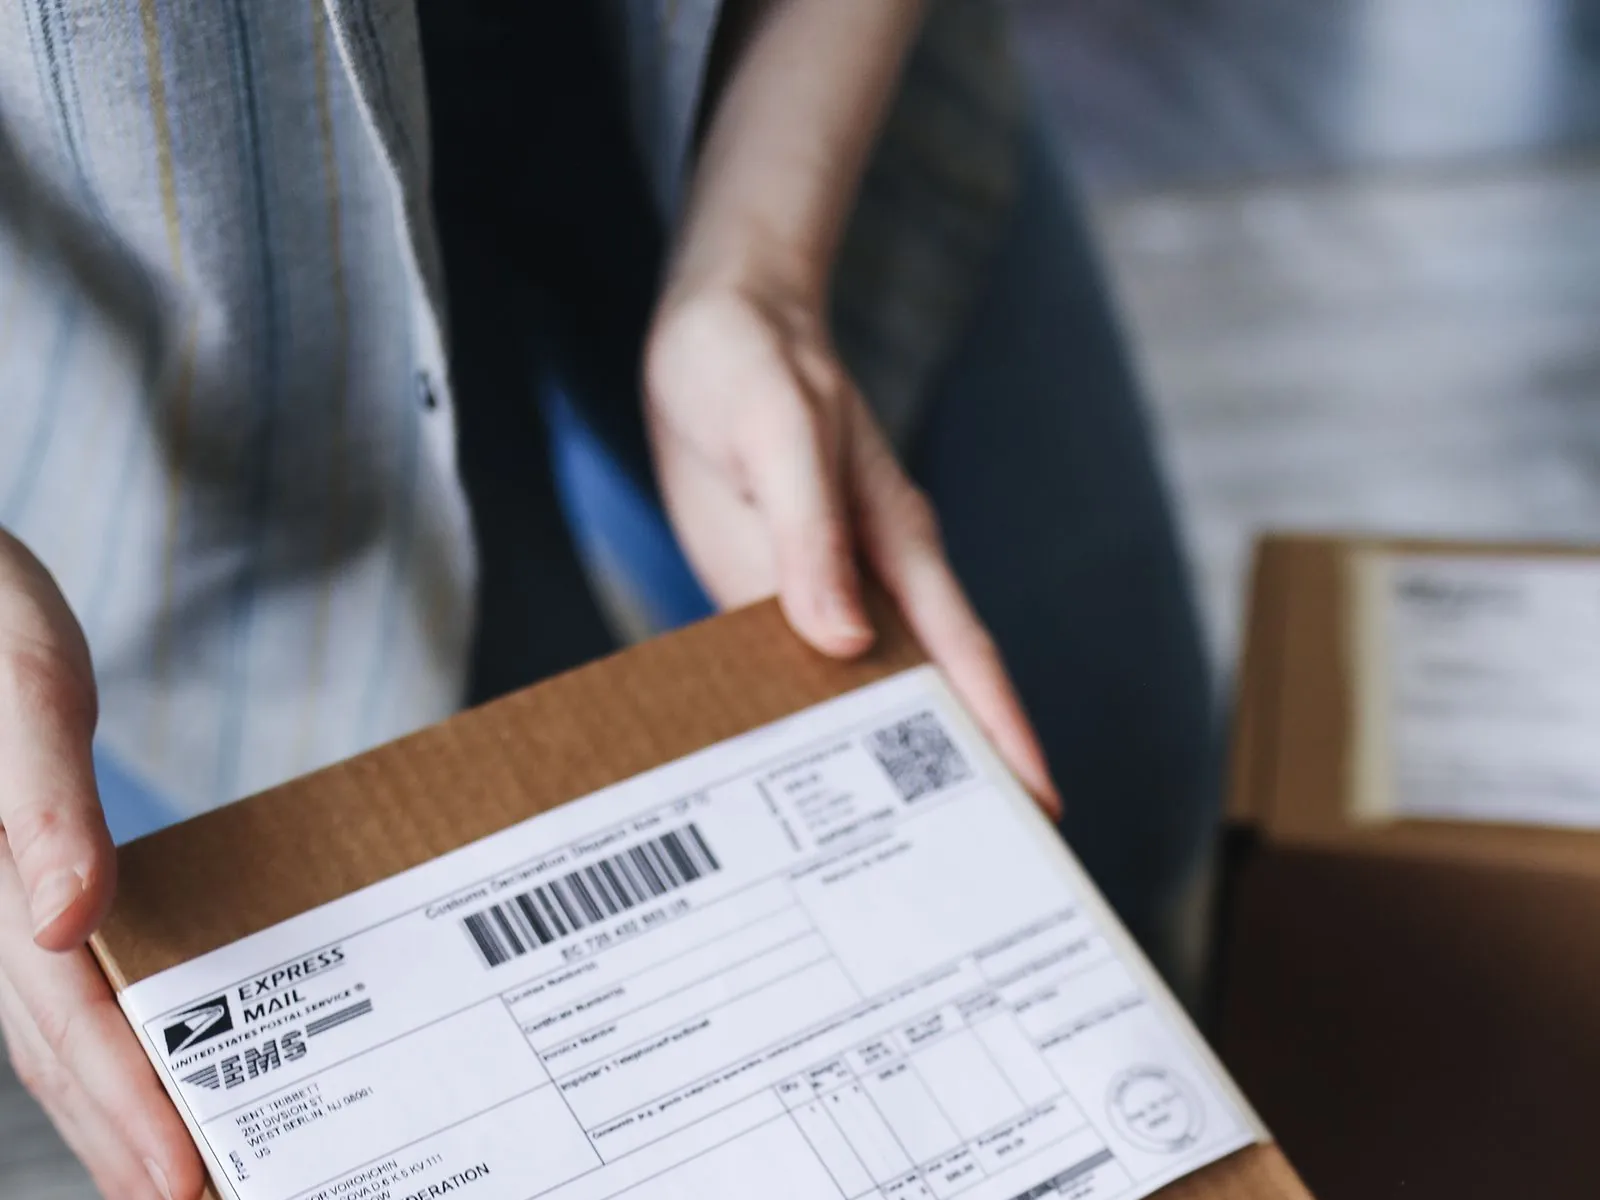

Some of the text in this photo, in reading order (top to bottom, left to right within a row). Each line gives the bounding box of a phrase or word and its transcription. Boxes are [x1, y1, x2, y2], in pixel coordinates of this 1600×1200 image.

[238, 948, 344, 1001] EXPRESS
[243, 989, 305, 1023] MAIL
[171, 989, 350, 1070] UNITED STATES POSTAL SERVICE
[212, 1030, 307, 1089] EMS
[235, 1083, 318, 1126] KENT TRIBBETT
[241, 1095, 323, 1137] 251 DIVSION ST
[247, 1126, 280, 1147] WEST
[326, 1100, 342, 1112] NJ
[228, 1151, 249, 1181] From
[254, 1147, 271, 1159] US
[329, 1159, 397, 1195] VORONCHIN
